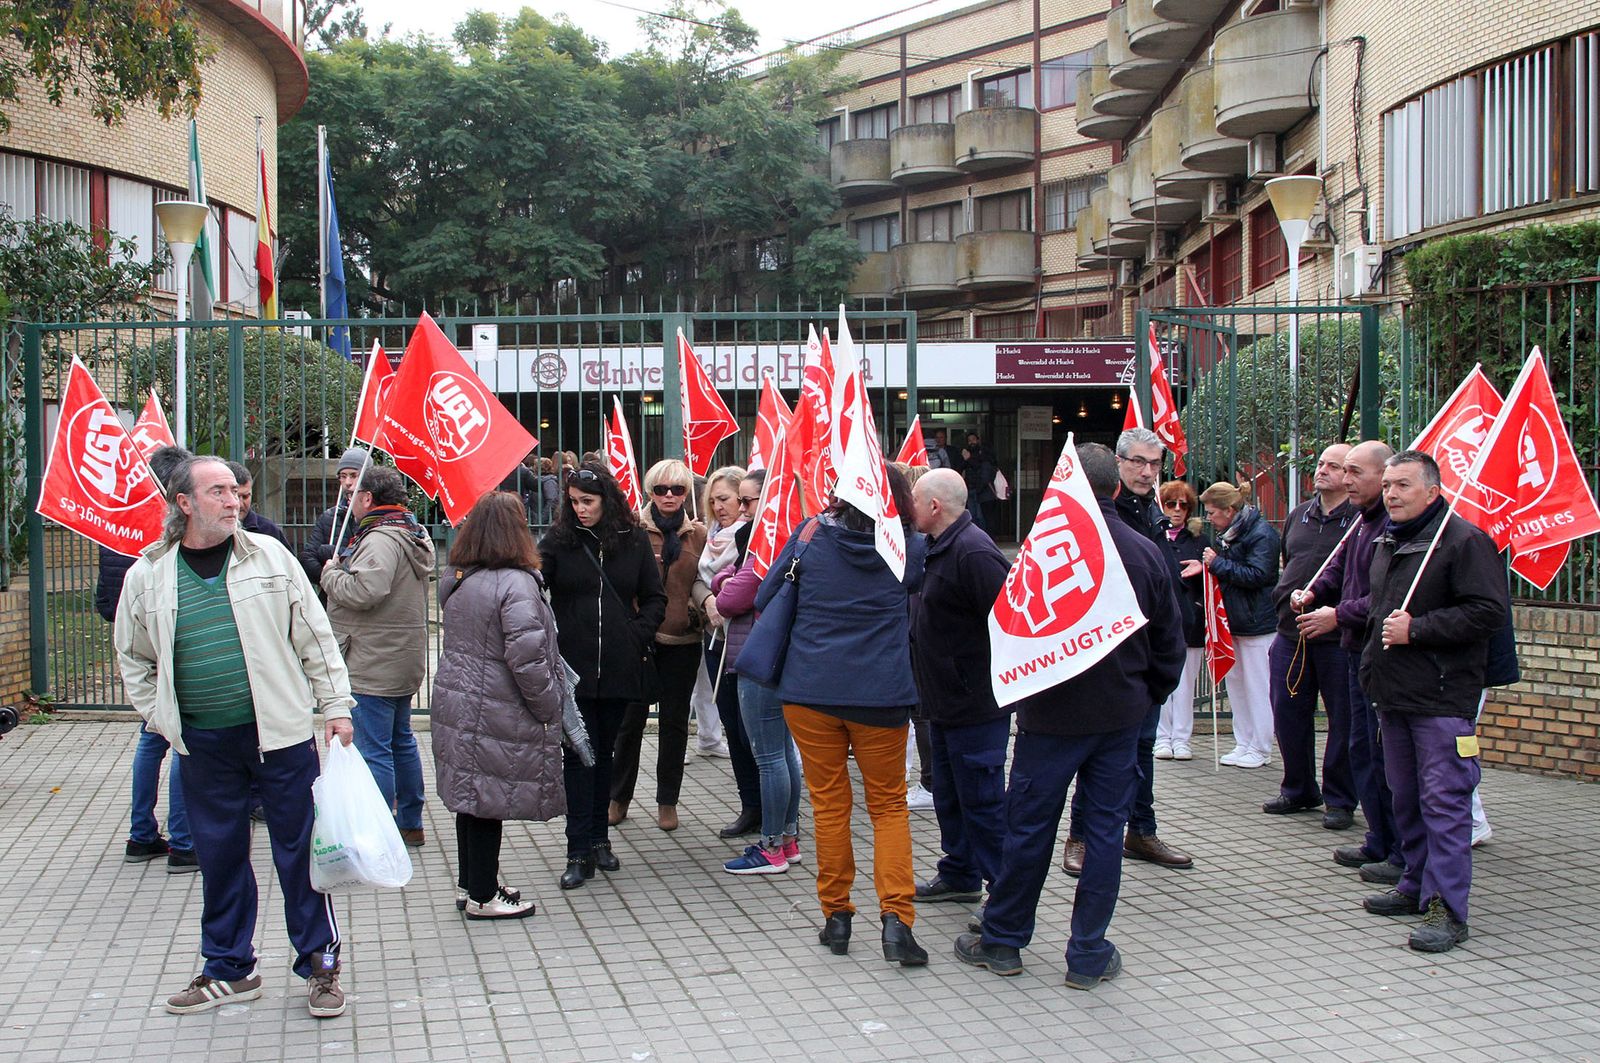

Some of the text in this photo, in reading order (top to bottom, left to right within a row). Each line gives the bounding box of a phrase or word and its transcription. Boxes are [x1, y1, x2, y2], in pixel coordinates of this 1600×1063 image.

[742, 353, 774, 383] de
[432, 376, 487, 439] UGT
[79, 407, 122, 496] UGT
[60, 497, 144, 542] www.ugt.es
[1031, 496, 1096, 604] UGT
[998, 614, 1136, 686] www.UGT.es
